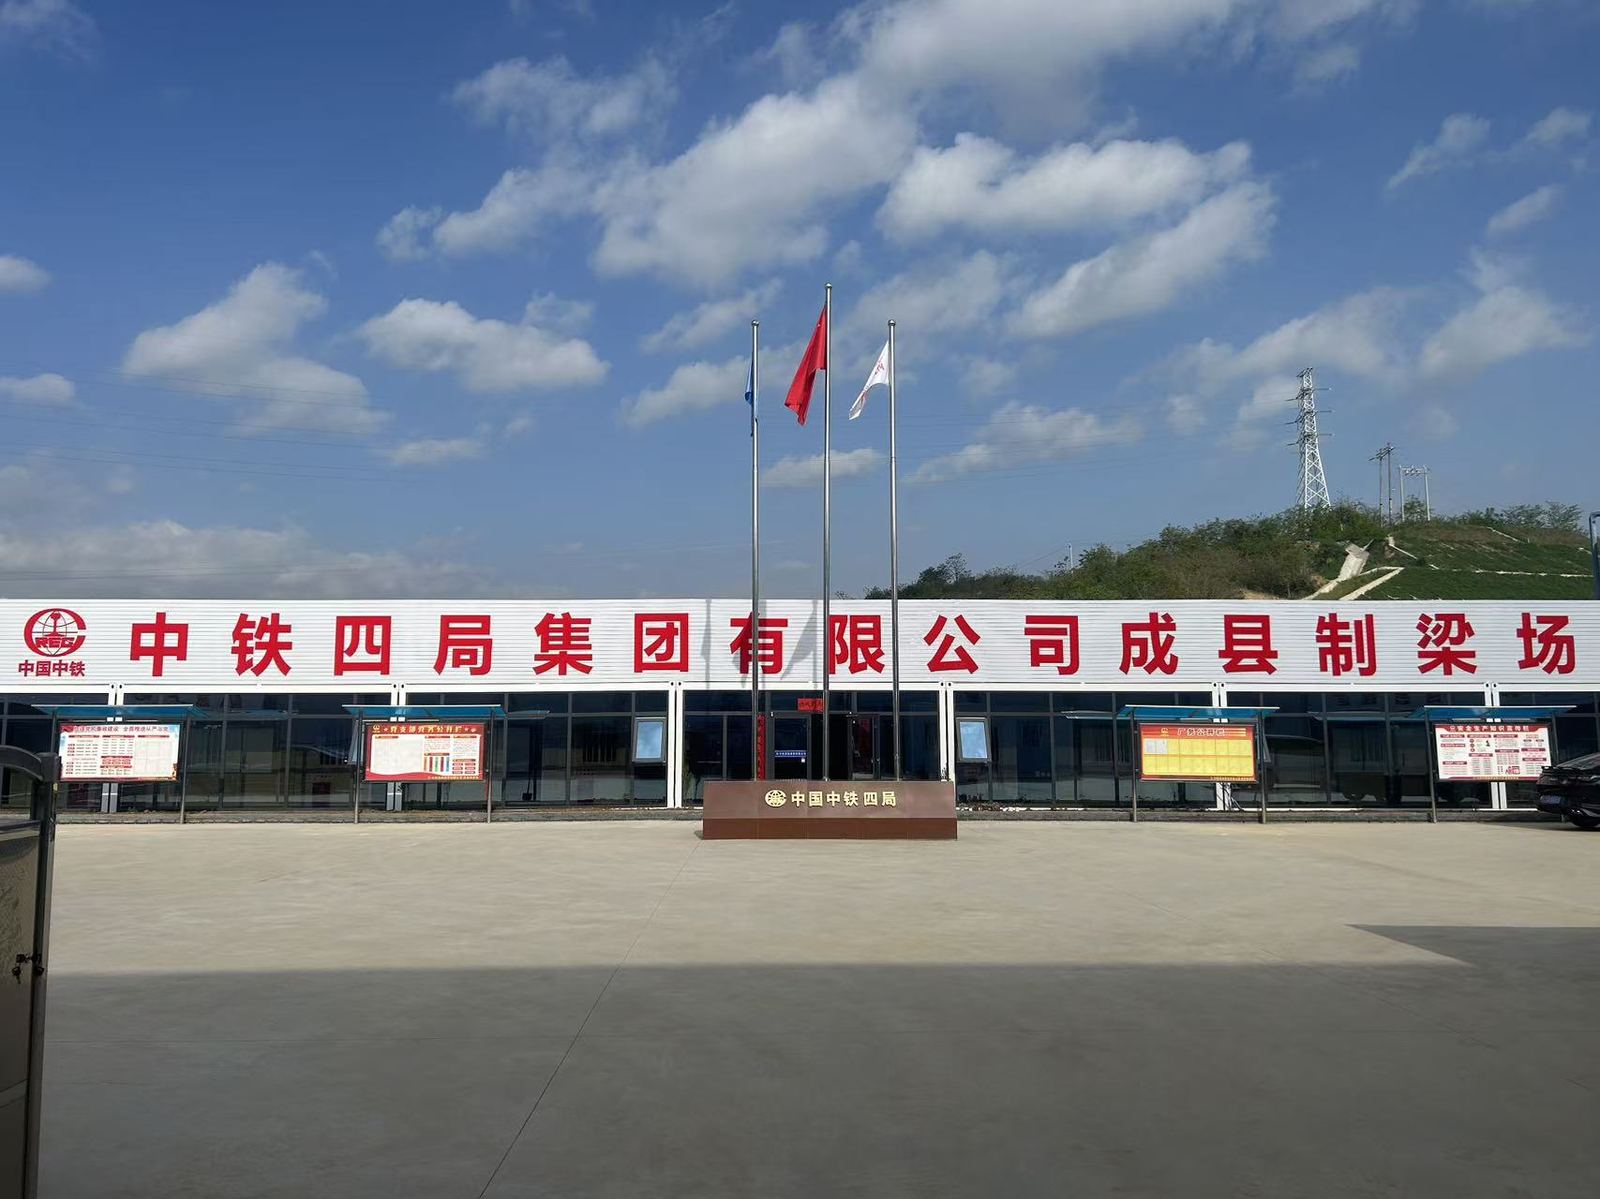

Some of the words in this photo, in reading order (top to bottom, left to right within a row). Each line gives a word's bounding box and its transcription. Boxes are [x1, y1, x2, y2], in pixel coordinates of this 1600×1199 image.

[130, 612, 1575, 677] 中铁四局集团有限公司成县制梁场
[18, 659, 86, 677] 中国中铁
[791, 791, 896, 807] 中国中铁四局
